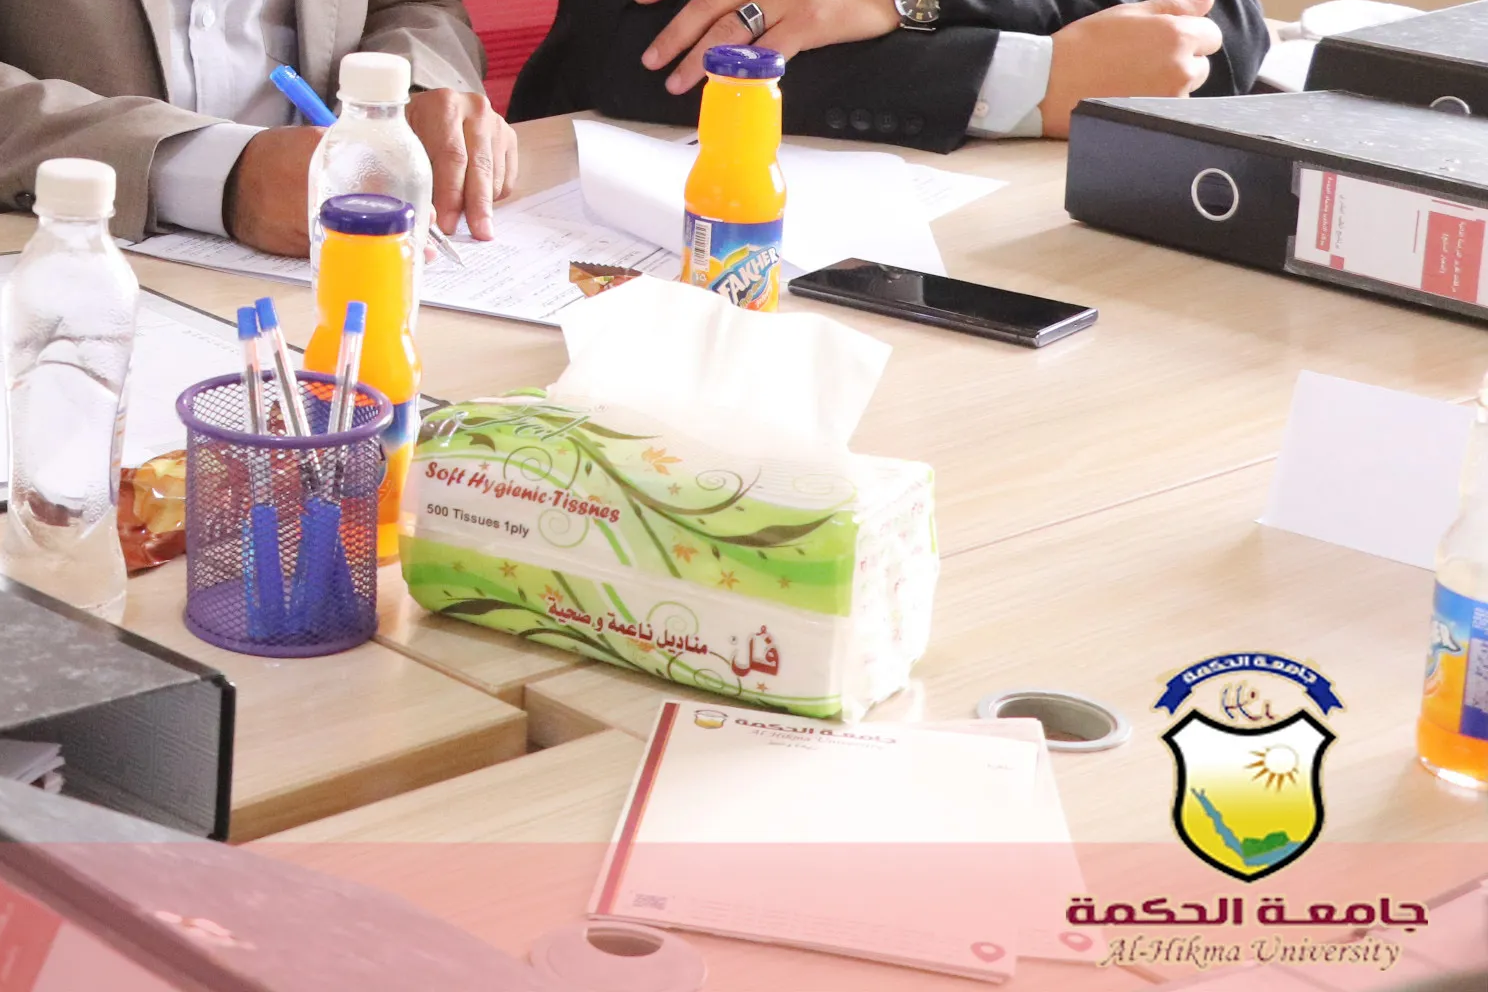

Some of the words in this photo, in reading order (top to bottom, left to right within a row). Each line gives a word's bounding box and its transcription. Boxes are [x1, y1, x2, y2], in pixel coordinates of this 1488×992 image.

[425, 461, 465, 487] Soft
[468, 472, 548, 504] Hygienic
[426, 503, 449, 517] 500
[453, 508, 500, 529] Tissues
[504, 521, 530, 538] 1ply
[548, 596, 592, 624] صحية
[608, 612, 653, 641] ناعمة
[657, 629, 708, 655] مناديل
